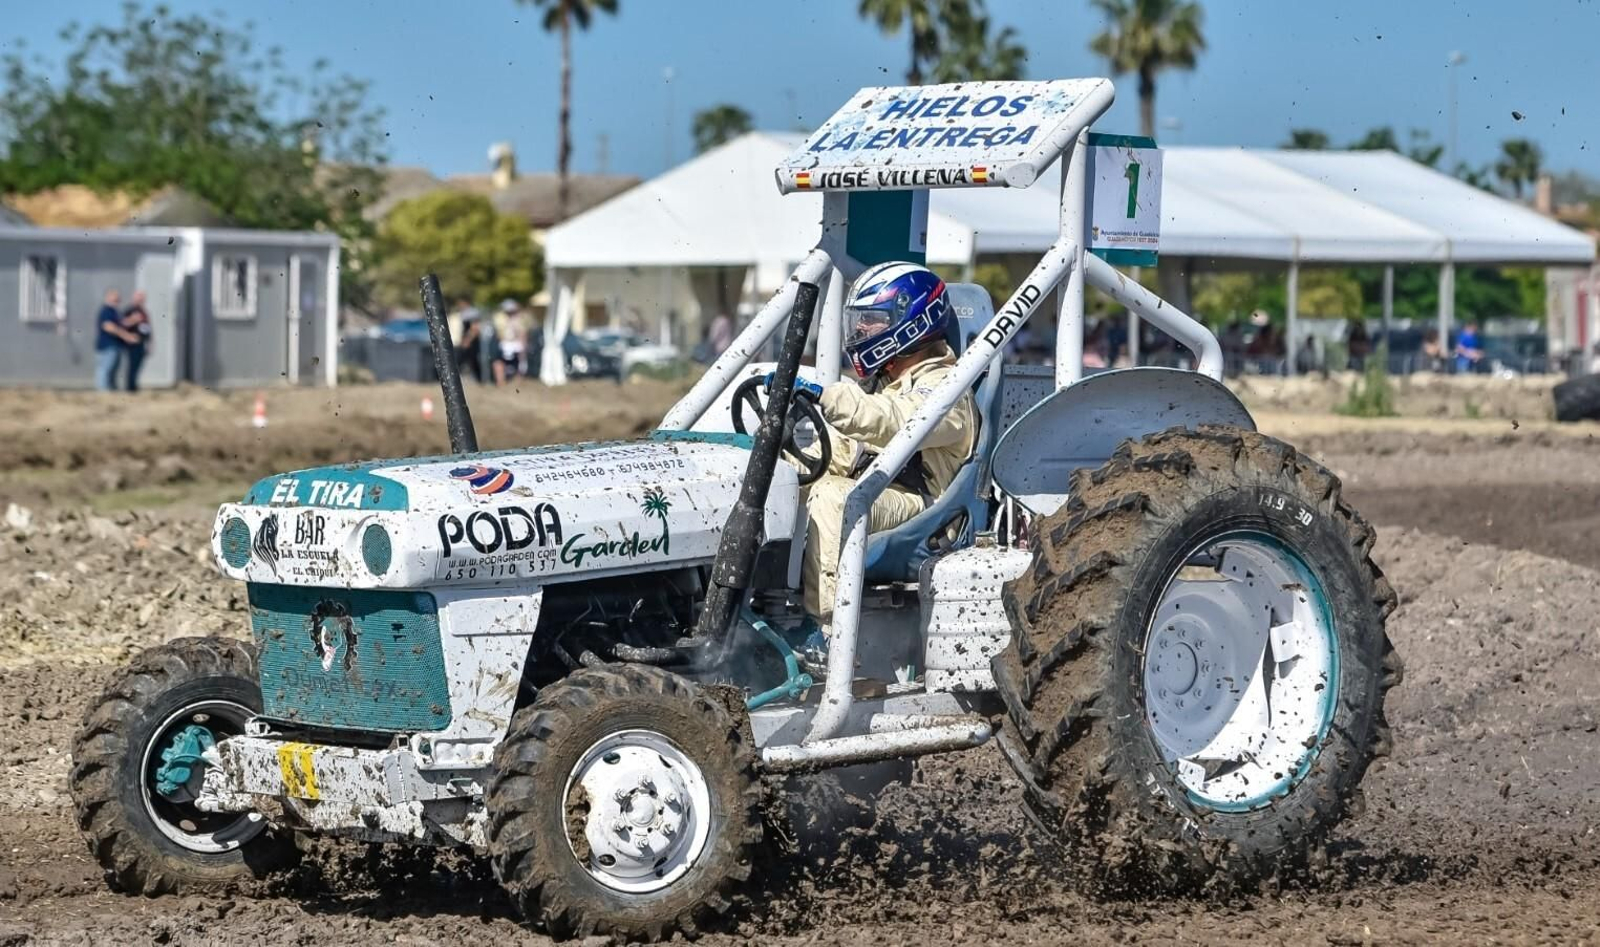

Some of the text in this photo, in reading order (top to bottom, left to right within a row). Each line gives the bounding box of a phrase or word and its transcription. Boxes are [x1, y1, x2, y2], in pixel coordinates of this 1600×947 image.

[878, 95, 1035, 121] HIELOS
[808, 125, 1040, 152] LA ENTREGA
[815, 167, 969, 188] JOSÉ VILLENA
[1124, 163, 1141, 219] 1
[983, 284, 1042, 349] DAVID
[270, 479, 365, 508] EL TIRA
[294, 514, 325, 546] BAR
[438, 502, 563, 558] PODA
[1294, 507, 1313, 526] 30
[281, 549, 339, 561] LA ESCUELA
[560, 522, 670, 567] Garden
[445, 559, 556, 581] 650 110 537
